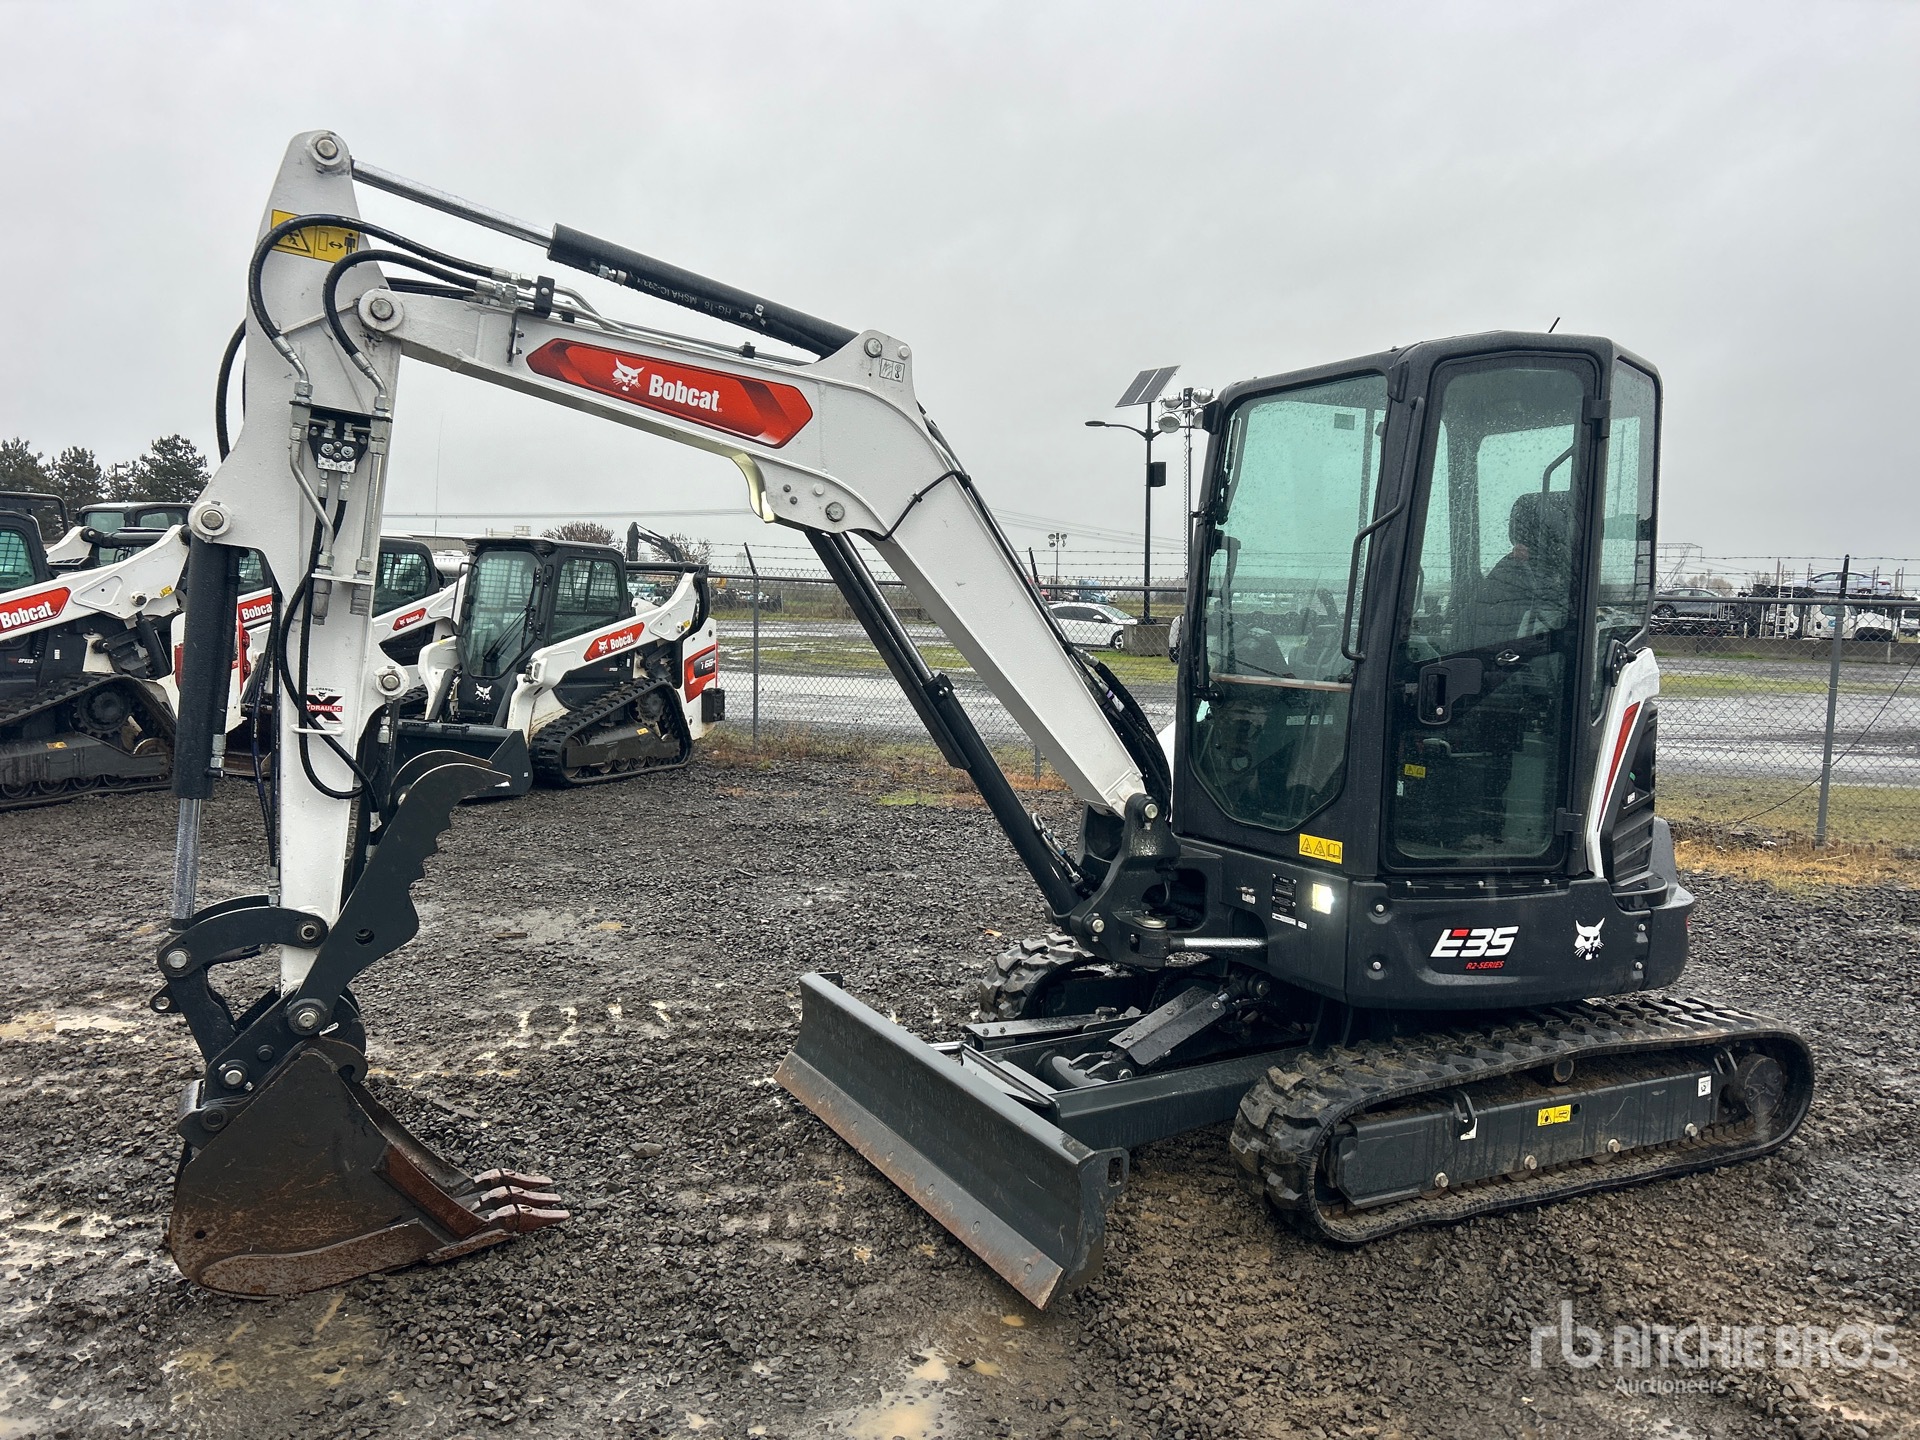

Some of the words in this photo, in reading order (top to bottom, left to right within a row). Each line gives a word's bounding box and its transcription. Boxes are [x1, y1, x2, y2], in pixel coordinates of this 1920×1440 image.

[672, 290, 698, 305] MSHA
[648, 373, 720, 412] Bobcat
[0, 601, 53, 629] Bobcat
[241, 602, 272, 620] Bobca
[610, 632, 634, 650] Bobcat
[307, 704, 341, 712] YDRAULIC
[1430, 925, 1519, 958] E35
[1466, 960, 1504, 970] R2-SERIES
